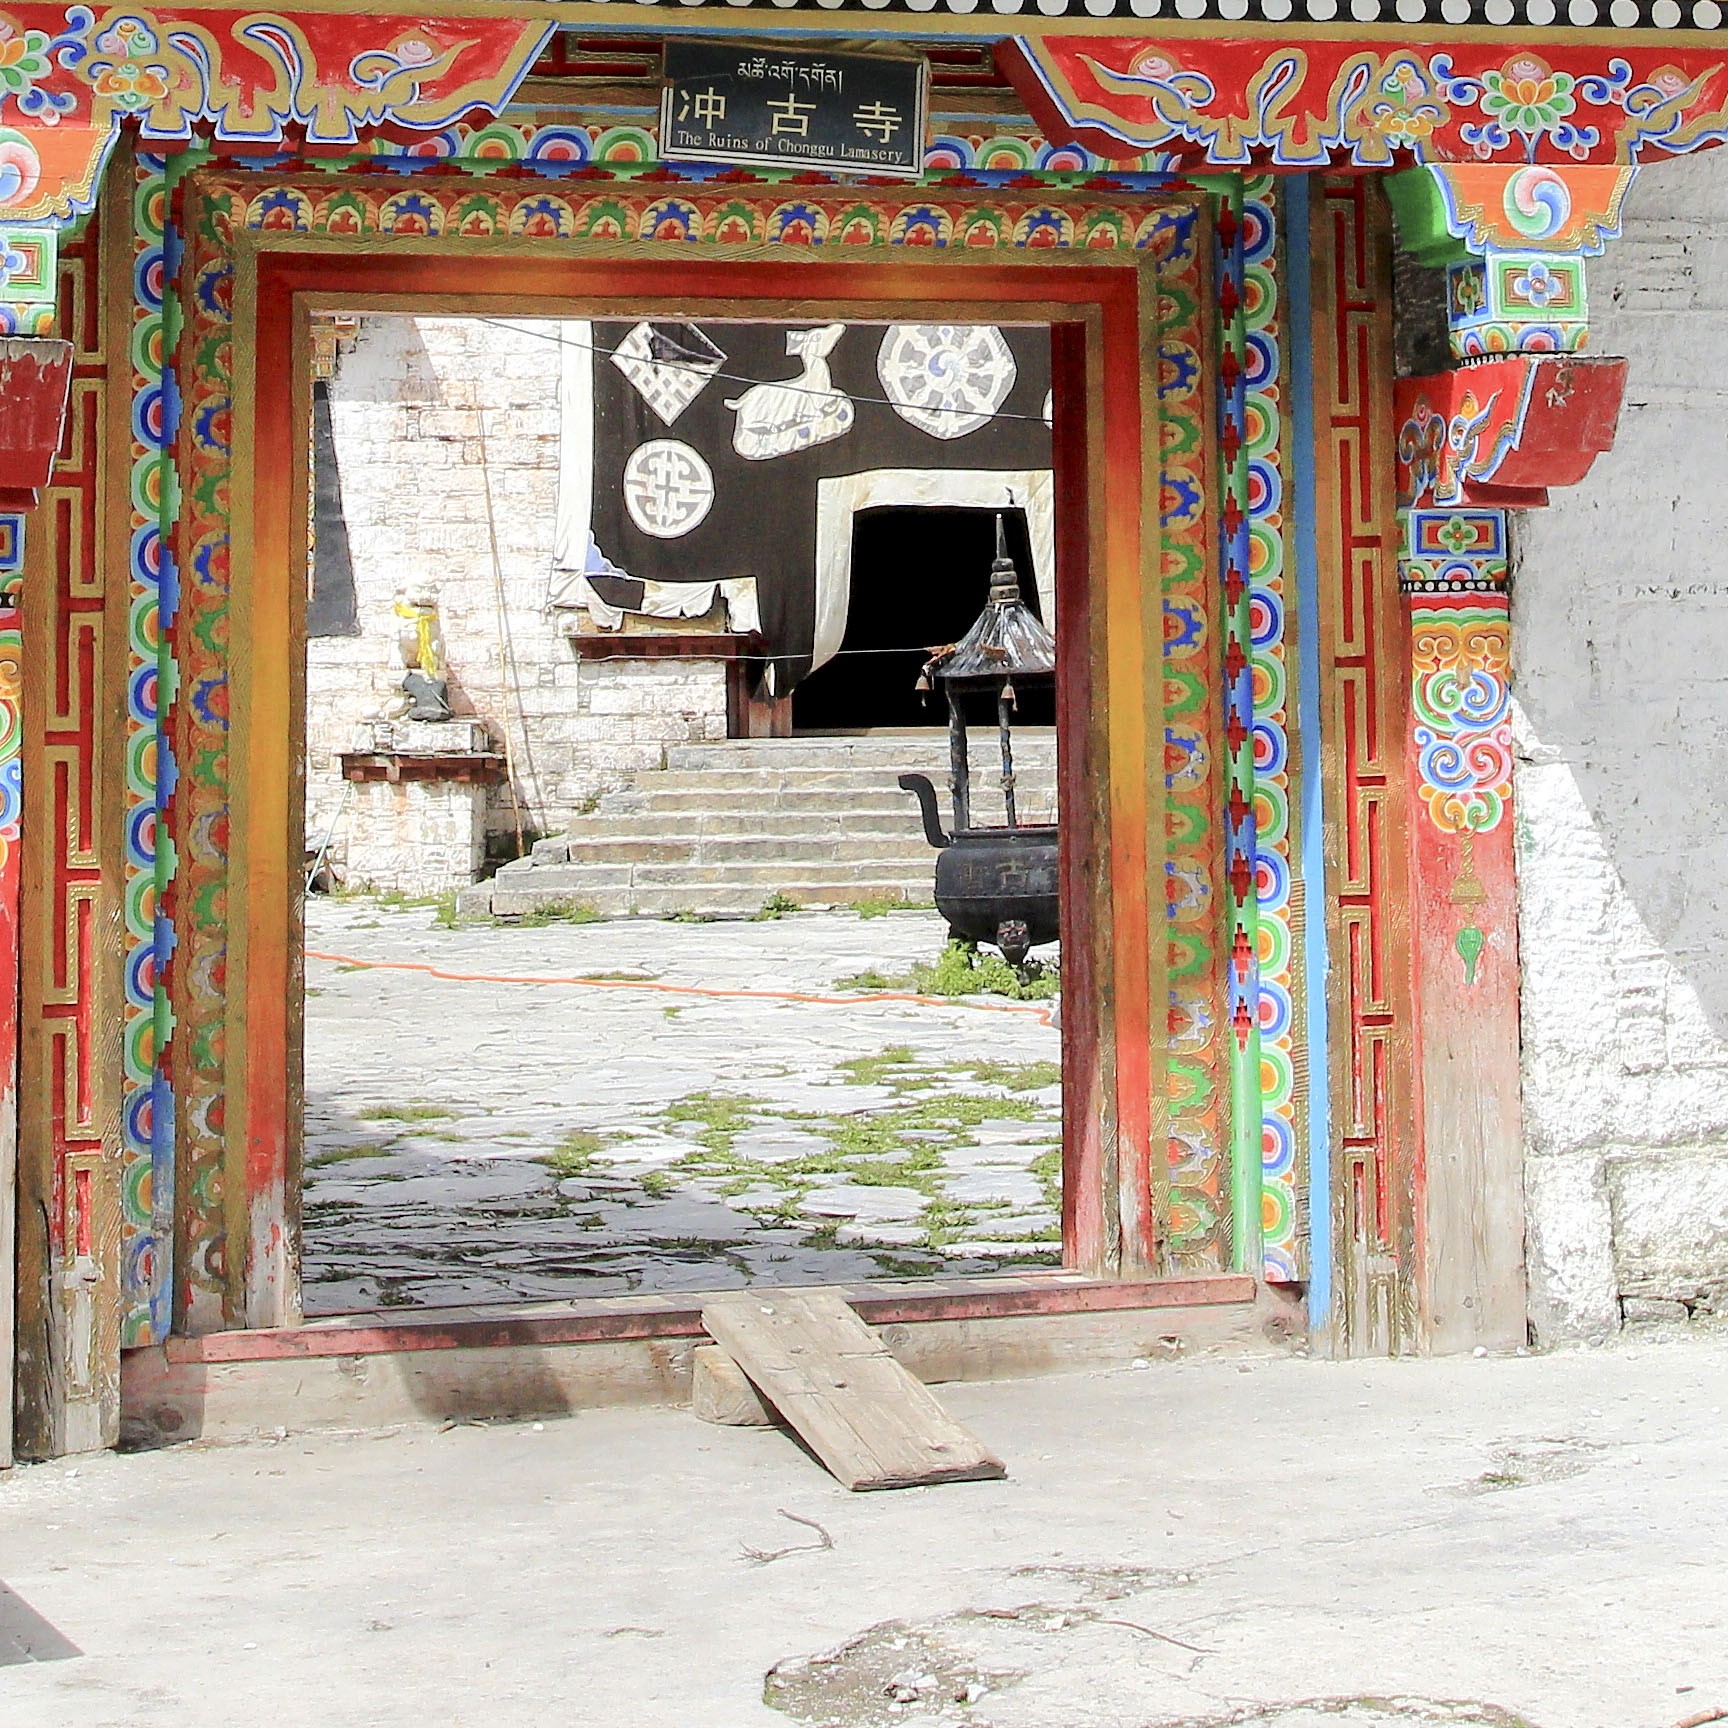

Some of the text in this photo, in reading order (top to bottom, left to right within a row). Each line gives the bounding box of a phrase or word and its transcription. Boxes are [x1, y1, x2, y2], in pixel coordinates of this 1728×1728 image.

[677, 86, 903, 144] 冲古寺
[677, 130, 903, 164] The Ruins of Chonggu Lamasery
